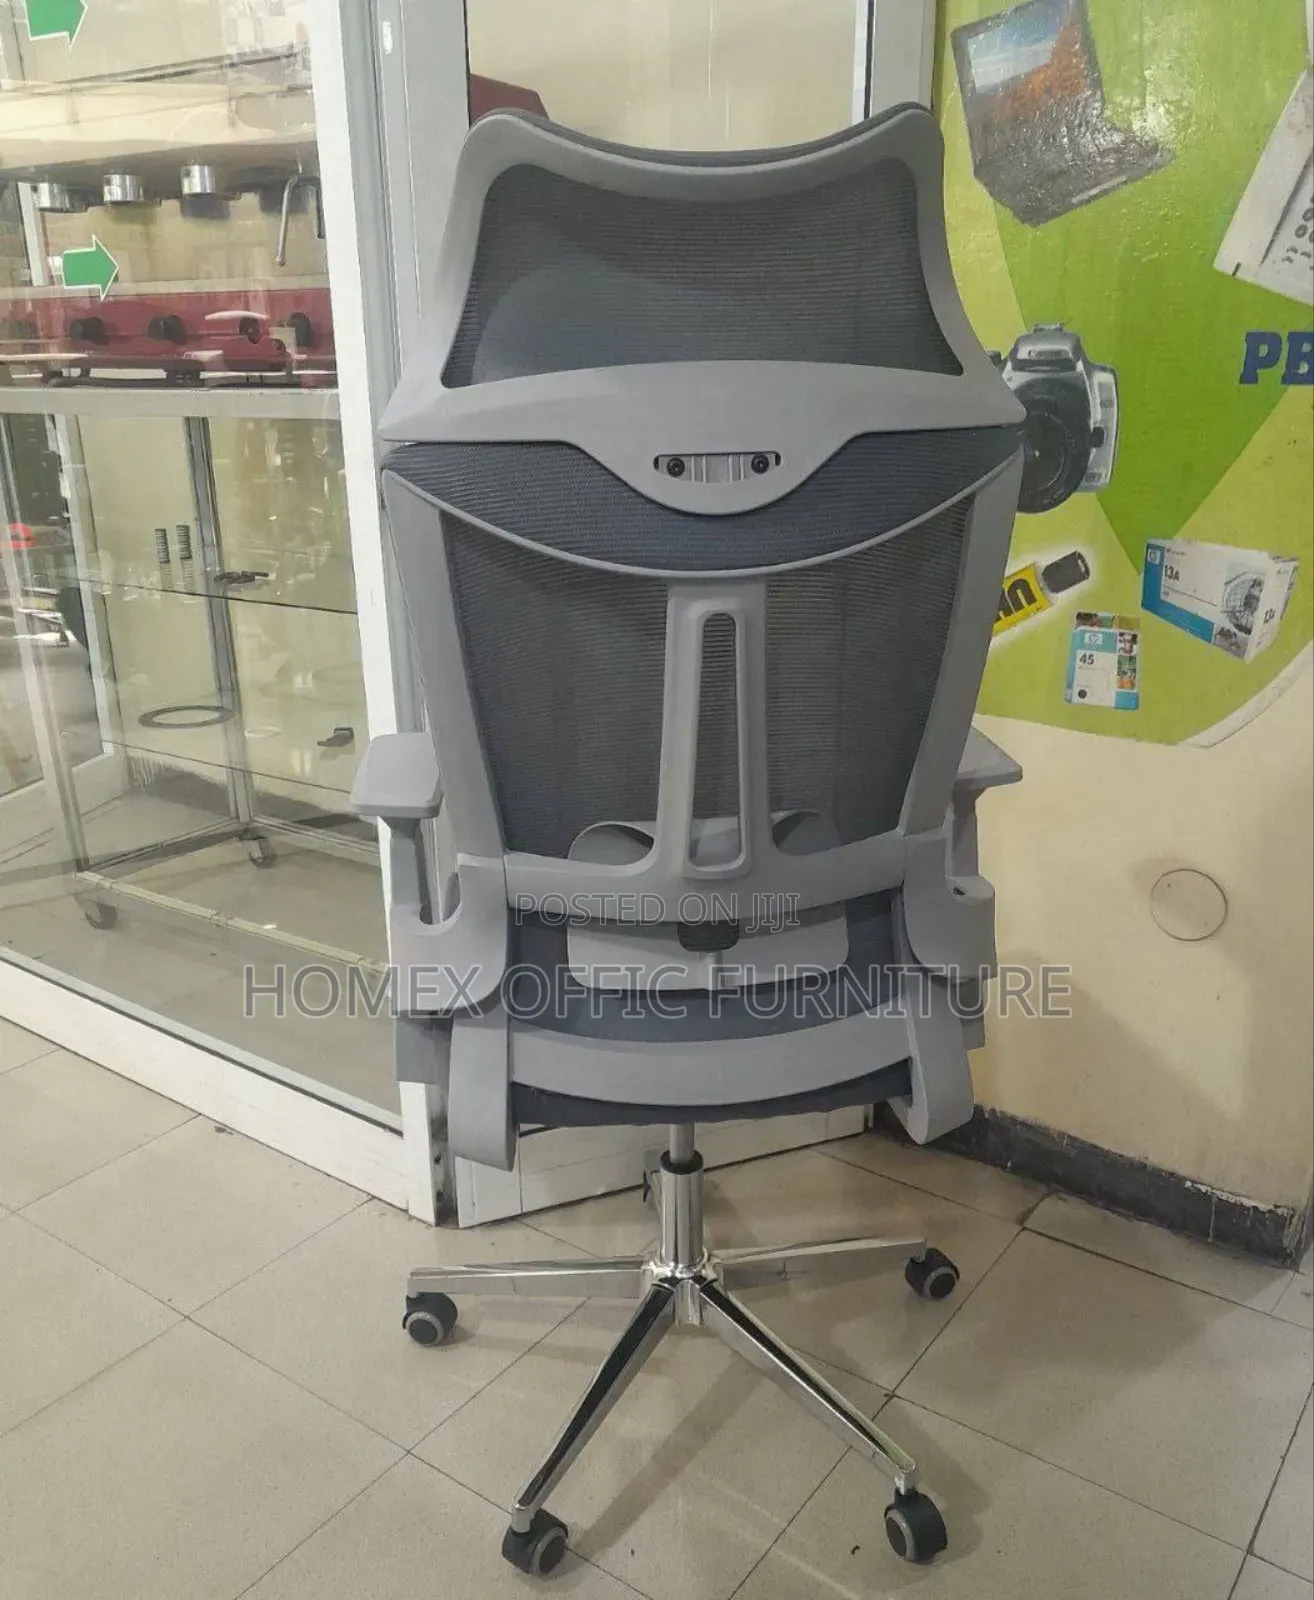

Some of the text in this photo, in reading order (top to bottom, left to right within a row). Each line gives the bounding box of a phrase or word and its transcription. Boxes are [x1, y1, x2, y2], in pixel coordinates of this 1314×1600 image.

[1239, 331, 1314, 384] PB
[1164, 564, 1180, 581] 13A
[1079, 652, 1095, 665] 45
